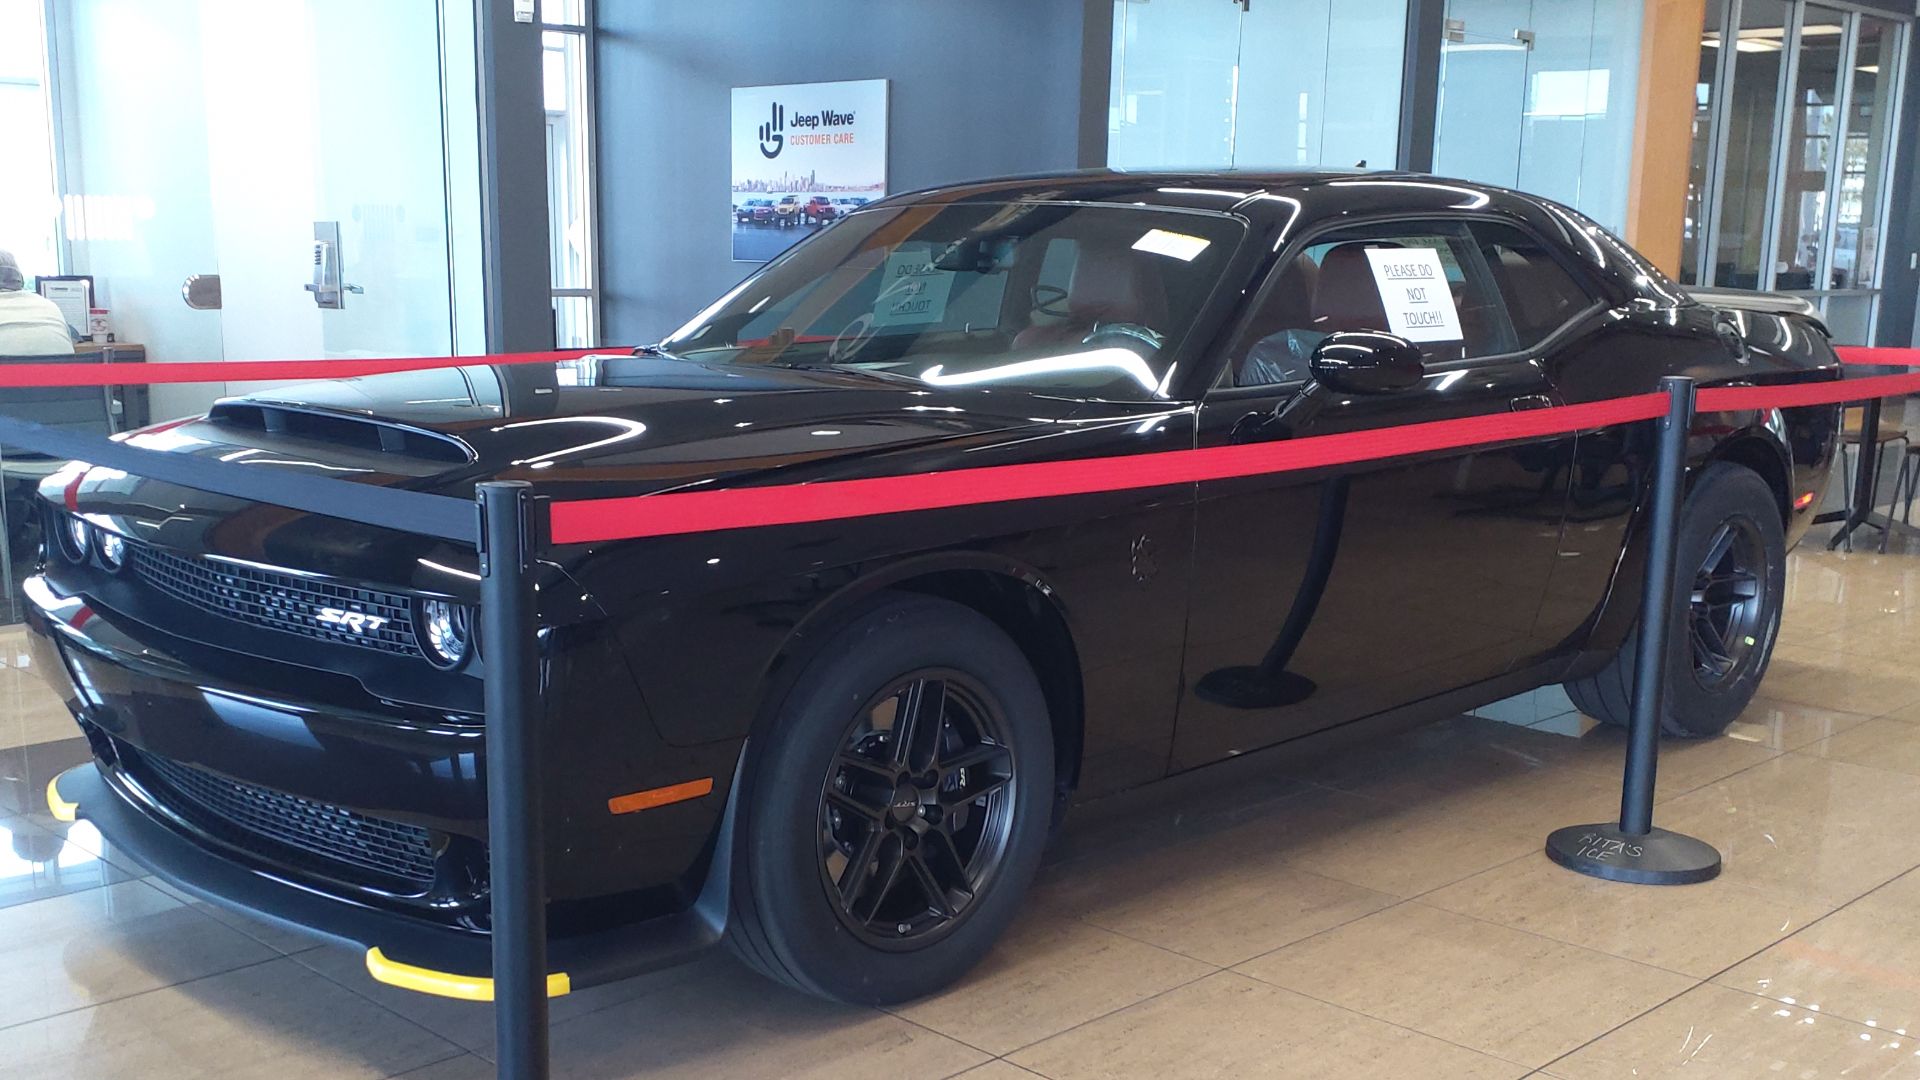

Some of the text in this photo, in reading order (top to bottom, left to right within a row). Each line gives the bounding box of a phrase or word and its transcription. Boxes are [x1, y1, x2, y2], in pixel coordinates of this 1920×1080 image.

[790, 111, 820, 130] Jeep
[790, 132, 854, 145] CUSTOMER CARE
[1383, 264, 1433, 277] PLEASE DO
[1406, 287, 1427, 300] NOT
[1403, 311, 1444, 325] TOUCH!!
[315, 607, 391, 633] SRT
[1576, 846, 1615, 861] ICE
